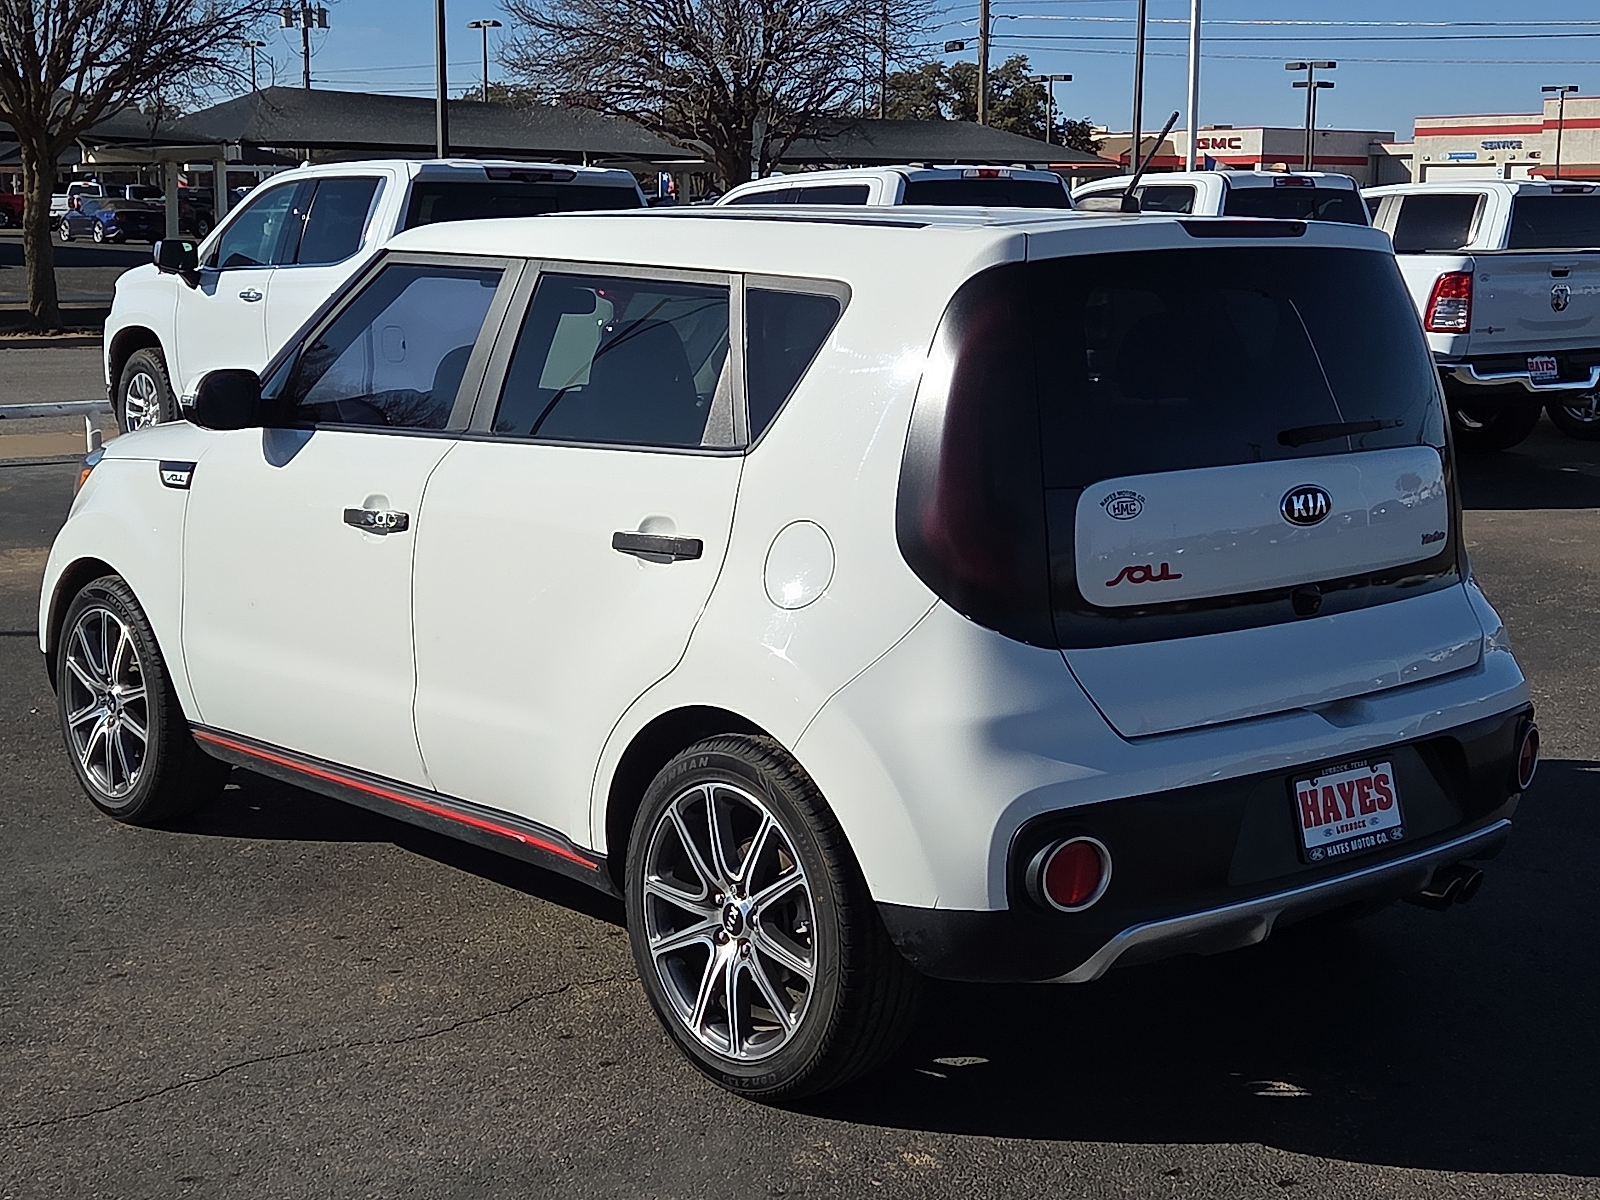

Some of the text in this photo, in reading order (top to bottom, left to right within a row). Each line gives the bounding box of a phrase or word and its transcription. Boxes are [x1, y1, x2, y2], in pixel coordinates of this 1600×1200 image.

[1195, 137, 1242, 150] GMC
[1481, 140, 1524, 150] SERVICE
[1291, 492, 1327, 518] KIA
[1299, 773, 1393, 829] HAYES
[1335, 819, 1367, 835] LUBBOCK
[1326, 841, 1350, 857] HAYES
[1350, 835, 1374, 851] MOTOR
[728, 905, 739, 931] KIA
